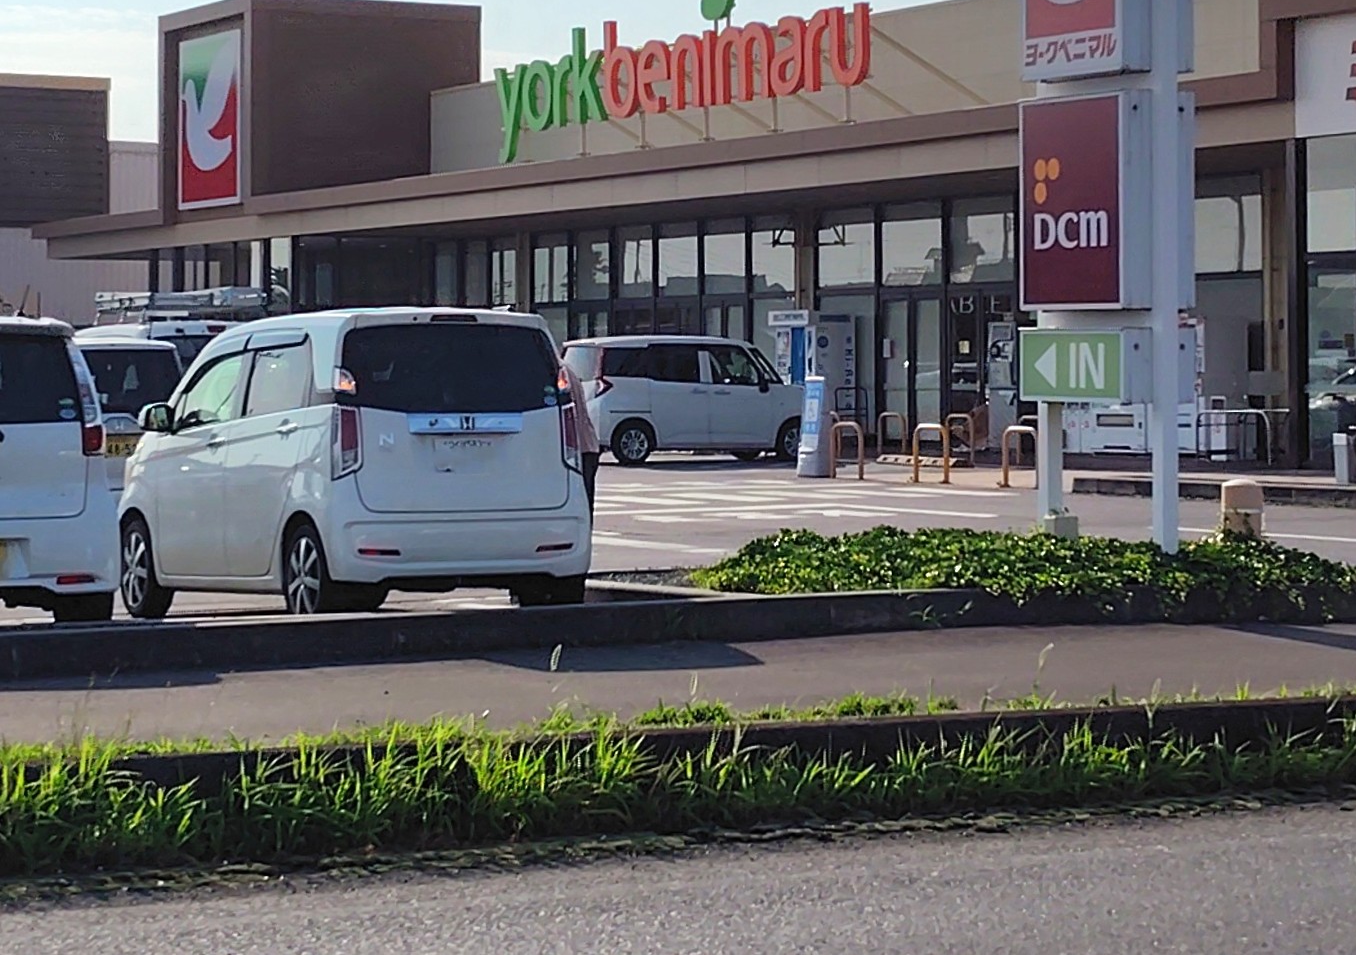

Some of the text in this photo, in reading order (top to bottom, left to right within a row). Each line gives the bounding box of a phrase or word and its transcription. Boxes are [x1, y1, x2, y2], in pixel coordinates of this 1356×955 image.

[1024, 33, 1117, 66] ヨークベニマル
[1069, 342, 1105, 389] IN
